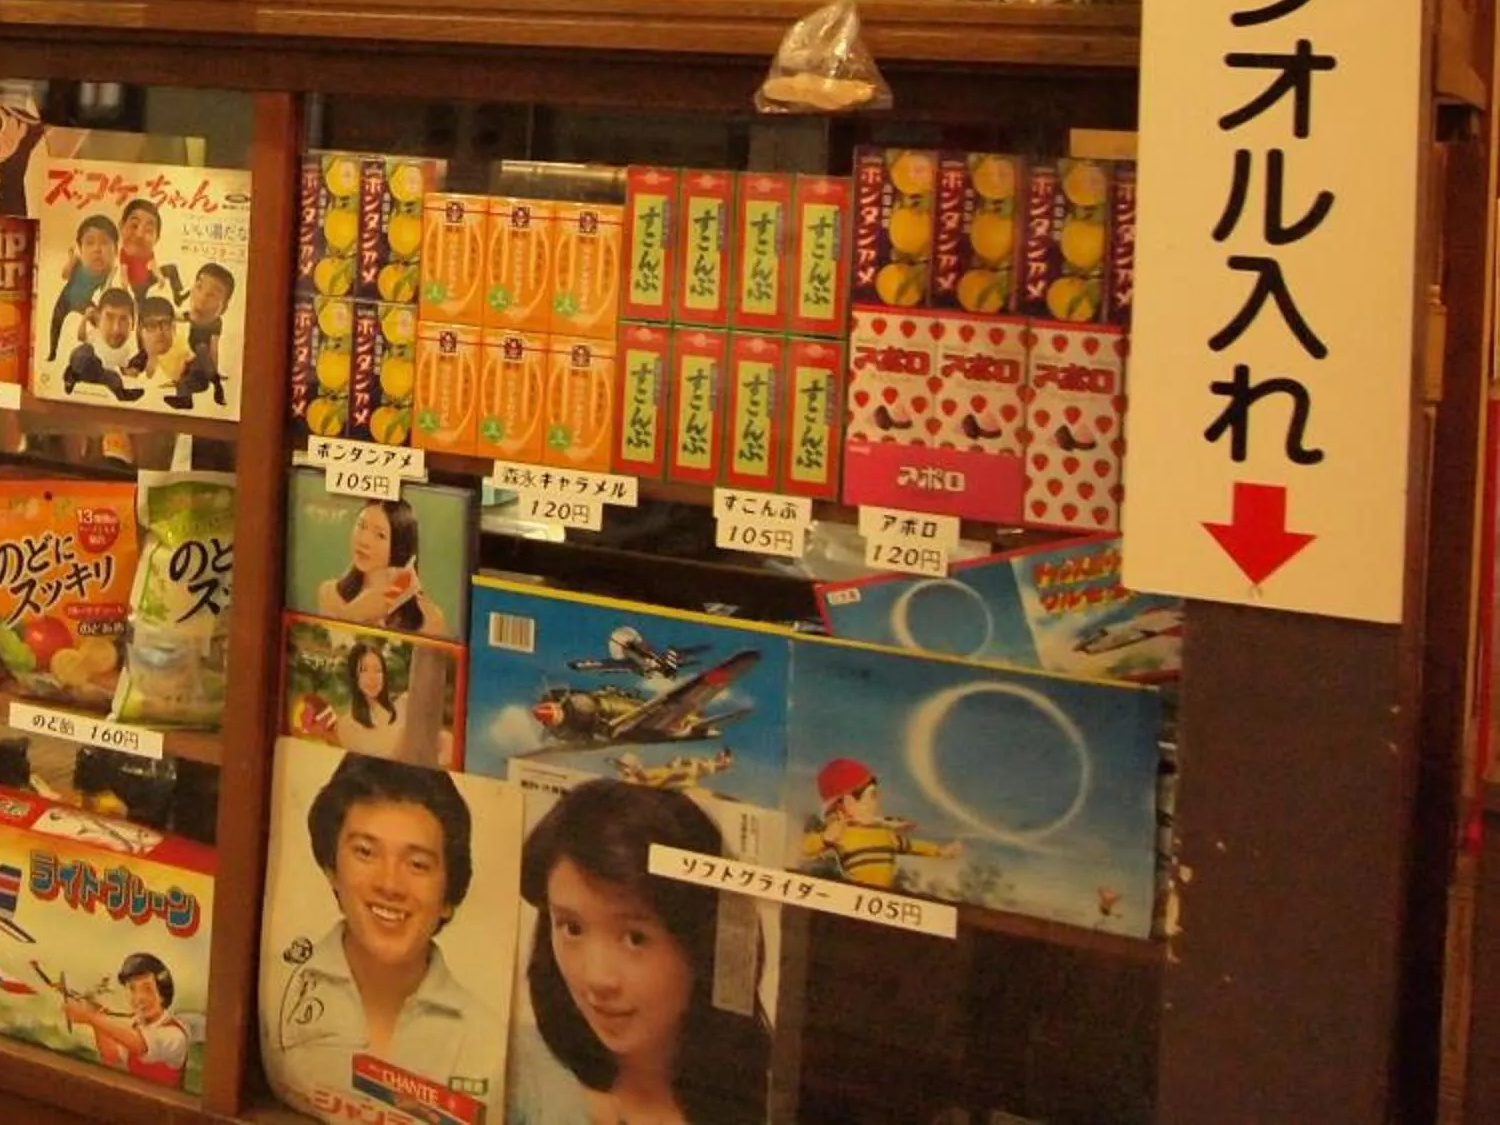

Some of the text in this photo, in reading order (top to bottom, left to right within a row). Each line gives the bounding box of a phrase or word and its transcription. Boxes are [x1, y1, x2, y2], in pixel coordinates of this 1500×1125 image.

[43, 167, 220, 213] ズッコケちゃん
[361, 176, 385, 284] ボンタンアメ
[635, 207, 660, 294] すこんぶ
[690, 209, 716, 297] すこんぶ
[747, 211, 774, 301] すこんぶ
[804, 215, 833, 305] すこんぶ
[857, 167, 880, 284] ボンタンアメ
[937, 171, 963, 289] ボンタンアメ
[1028, 177, 1053, 299] ボンタンアメ
[352, 317, 375, 426] ボンタンアメ
[942, 353, 1021, 384] アポロ
[1036, 362, 1116, 394] アポロ
[627, 362, 653, 450] すこんぶ
[682, 368, 709, 456] すこんぶ
[738, 373, 766, 463] すこんぶ
[797, 379, 825, 471] すこんぶ
[316, 443, 413, 468] ボンタンアメ
[335, 473, 390, 493] 105円
[501, 468, 627, 497] 森永キャラメル
[898, 466, 966, 492] アポロ
[530, 500, 590, 522] 120円
[724, 494, 797, 520] すこんぶ
[728, 525, 794, 551] 105円
[882, 514, 938, 537] アポロ
[5, 556, 113, 625] スッキリ
[872, 544, 942, 571] 120円
[176, 578, 230, 623] ス
[33, 713, 140, 747] のど飴 160円
[30, 851, 200, 937] ライトプレーン
[681, 856, 922, 926] ソフトグライダー 105円
[383, 1070, 438, 1104] CHANTE
